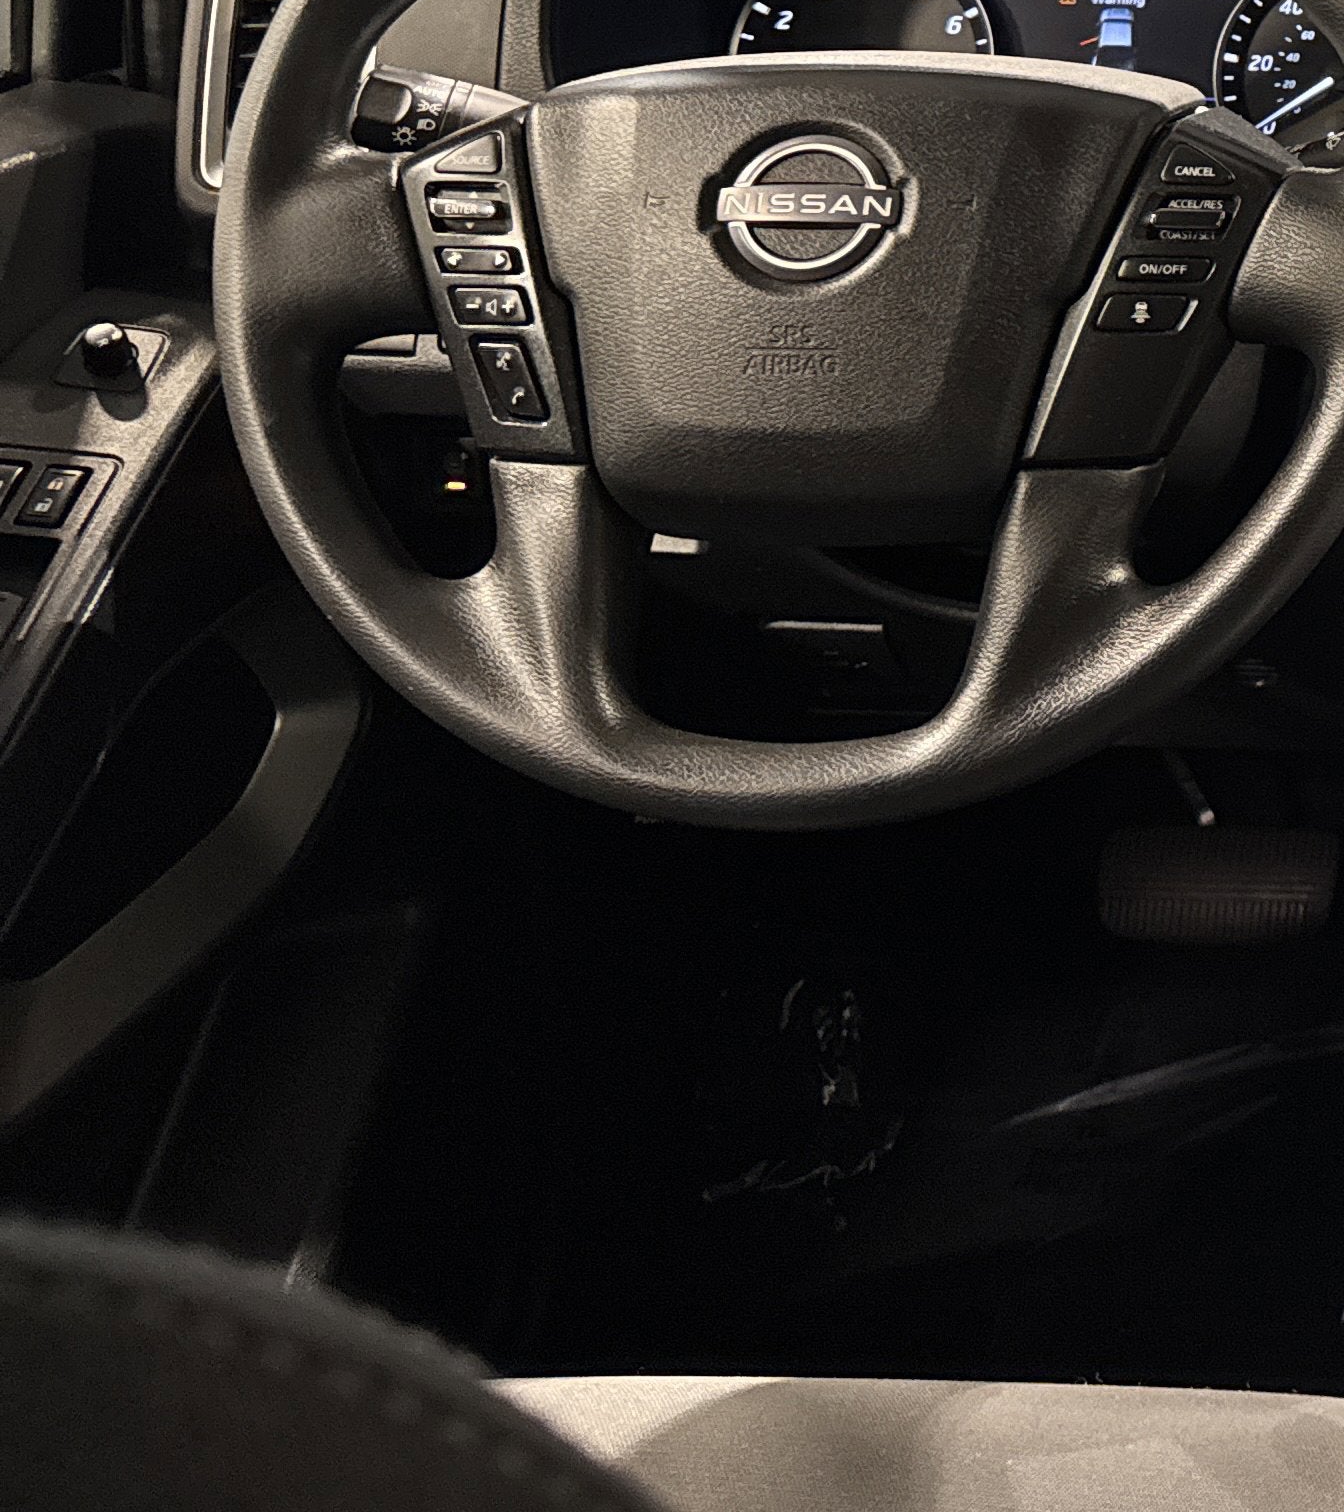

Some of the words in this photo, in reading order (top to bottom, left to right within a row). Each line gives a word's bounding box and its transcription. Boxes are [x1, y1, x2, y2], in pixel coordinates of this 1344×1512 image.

[773, 10, 794, 31] 2
[944, 15, 964, 35] 6
[1248, 54, 1273, 71] 20
[451, 155, 490, 166] SOURCE
[1174, 166, 1217, 177] CANCEL
[444, 203, 478, 215] ENTER
[723, 192, 893, 217] NISSAN
[1168, 199, 1224, 209] ACCEL/RES
[1139, 264, 1189, 275] ON/OFF
[769, 325, 813, 345] SRS
[742, 354, 839, 375] AIRBAG
